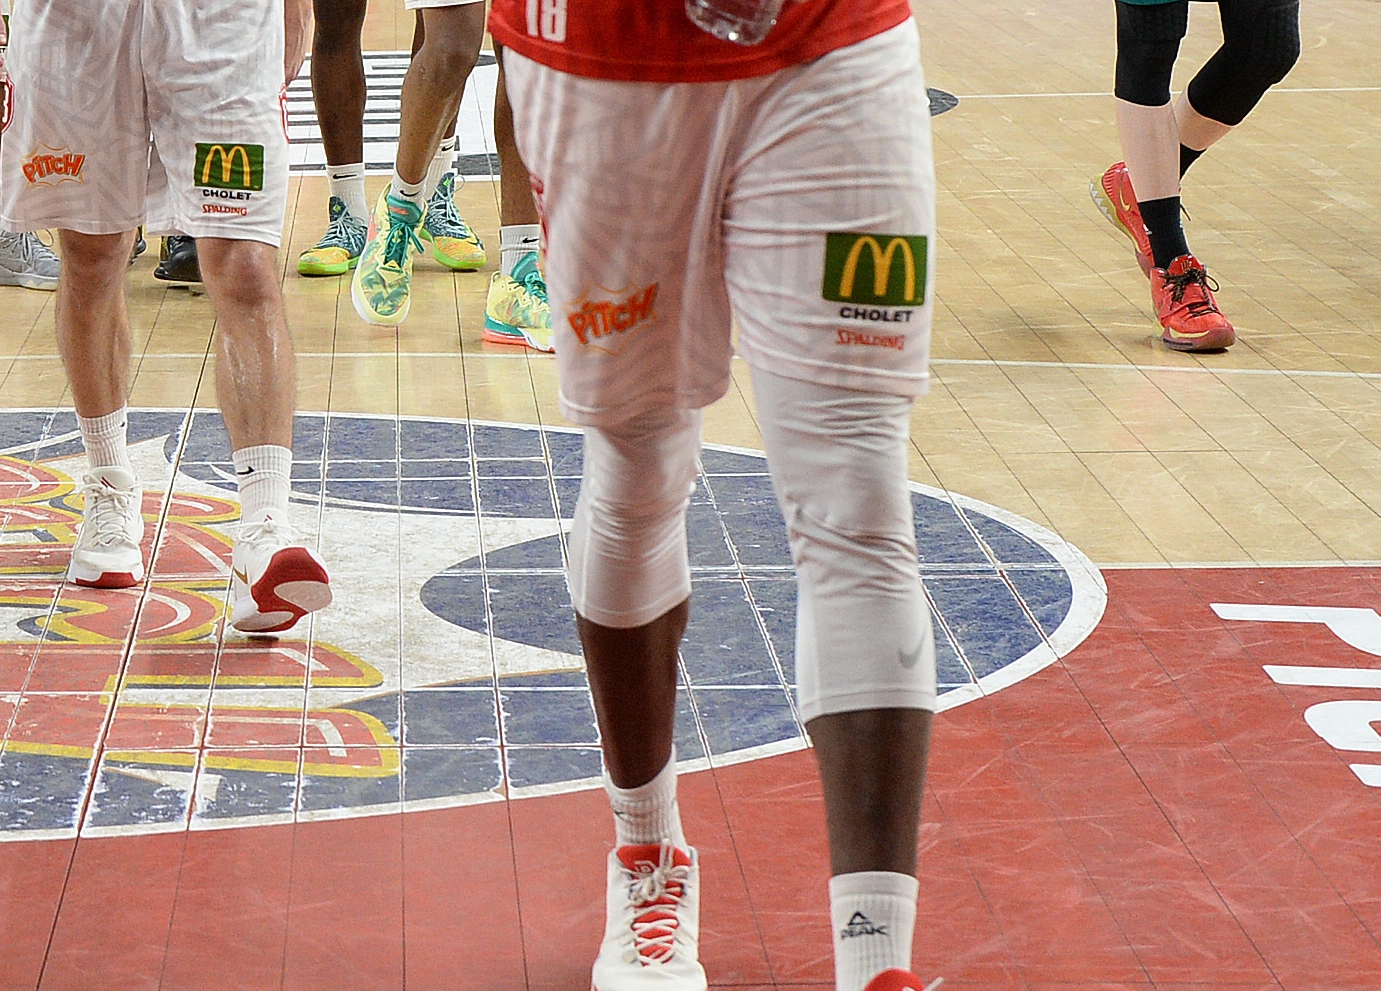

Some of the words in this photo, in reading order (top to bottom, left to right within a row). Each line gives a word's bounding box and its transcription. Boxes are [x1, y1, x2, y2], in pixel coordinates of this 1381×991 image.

[202, 189, 252, 201] CHOLET
[202, 204, 248, 216] SPALDING
[839, 307, 913, 323] CHOLET
